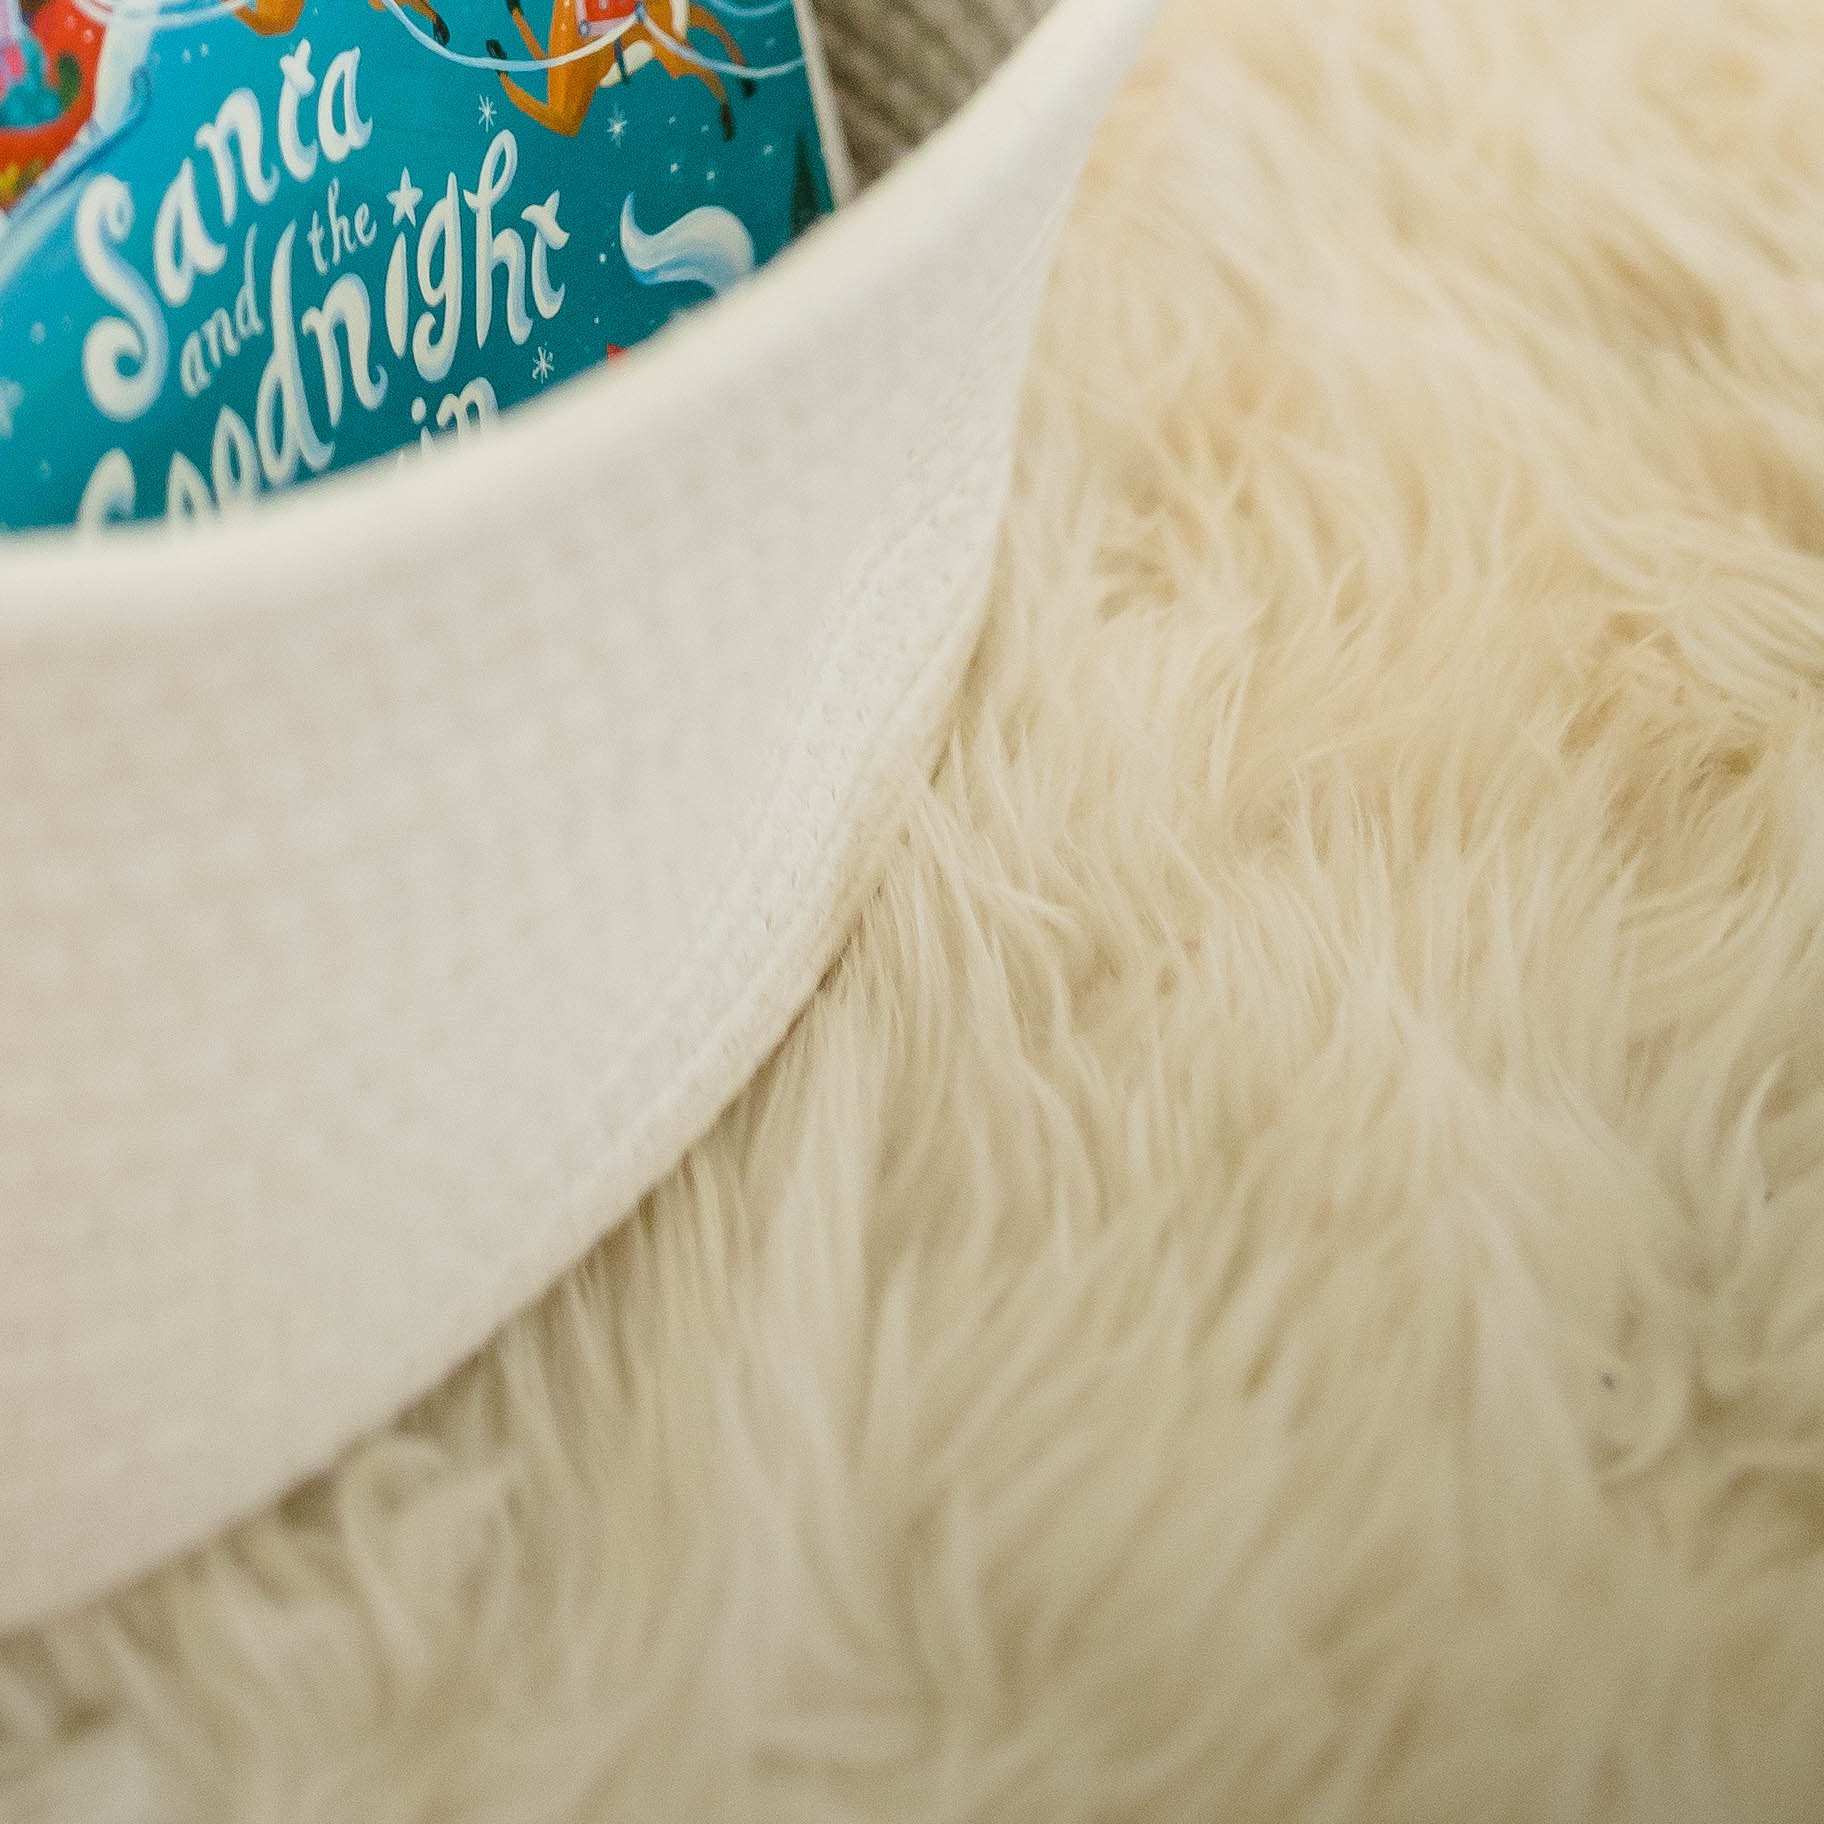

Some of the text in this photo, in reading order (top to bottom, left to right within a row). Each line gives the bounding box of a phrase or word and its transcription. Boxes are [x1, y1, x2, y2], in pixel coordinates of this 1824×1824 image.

[78, 38, 373, 421] Santa
[180, 177, 377, 398] and the
